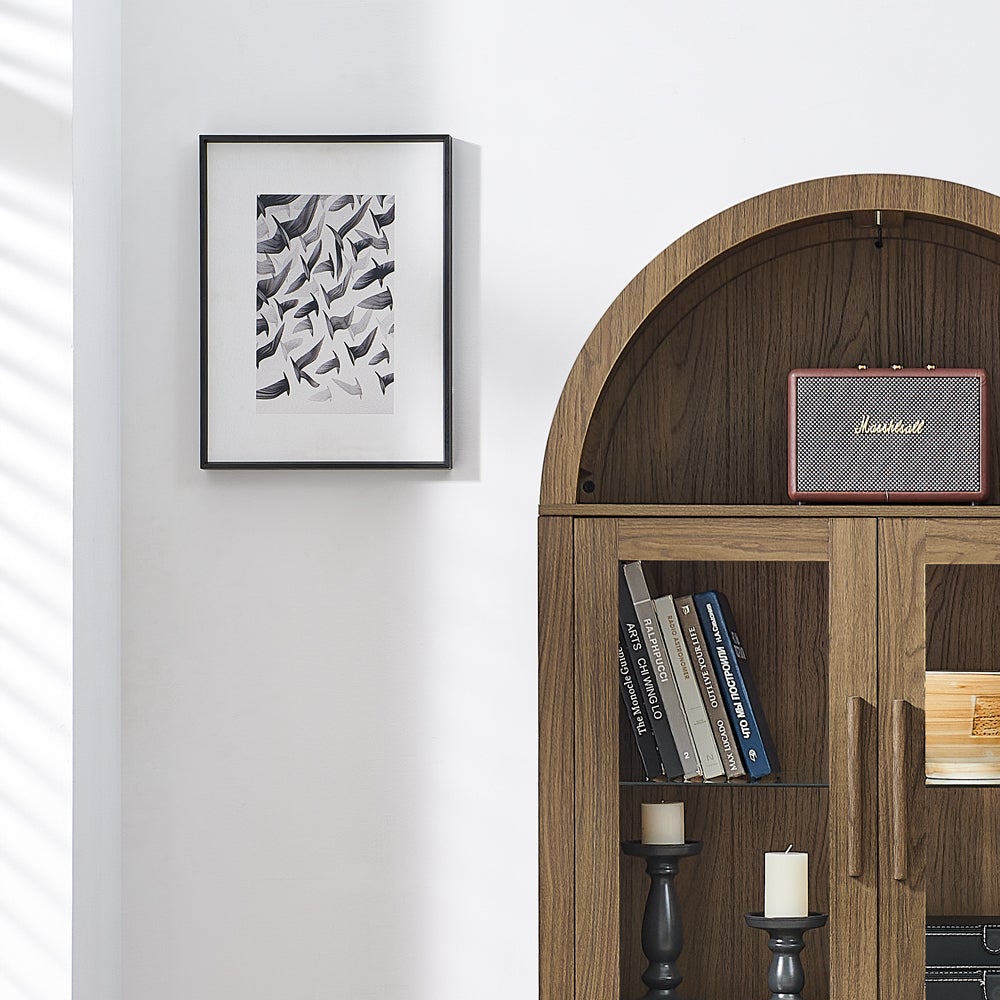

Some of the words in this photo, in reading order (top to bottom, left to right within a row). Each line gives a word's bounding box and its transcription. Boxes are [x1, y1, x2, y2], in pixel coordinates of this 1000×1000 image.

[626, 623, 642, 651] ARTS
[667, 615, 677, 636] RADIO
[673, 637, 690, 680] ASTRONOMER
[688, 626, 700, 646] LIFE
[643, 618, 669, 683] RALPHPUCCI
[694, 644, 709, 670] YOUR
[637, 657, 650, 676] CHI
[715, 646, 740, 700] ПОСТРОИЛИ
[623, 675, 642, 716] Monocle
[643, 676, 658, 704] WING
[701, 669, 718, 708] OUTLIVE
[651, 705, 663, 720] LO
[733, 702, 746, 718] МЫ
[636, 715, 647, 736] The
[716, 719, 731, 751] LUCADO
[739, 719, 751, 739] ЧТО
[683, 751, 690, 760] 2
[726, 753, 738, 771] MAX
